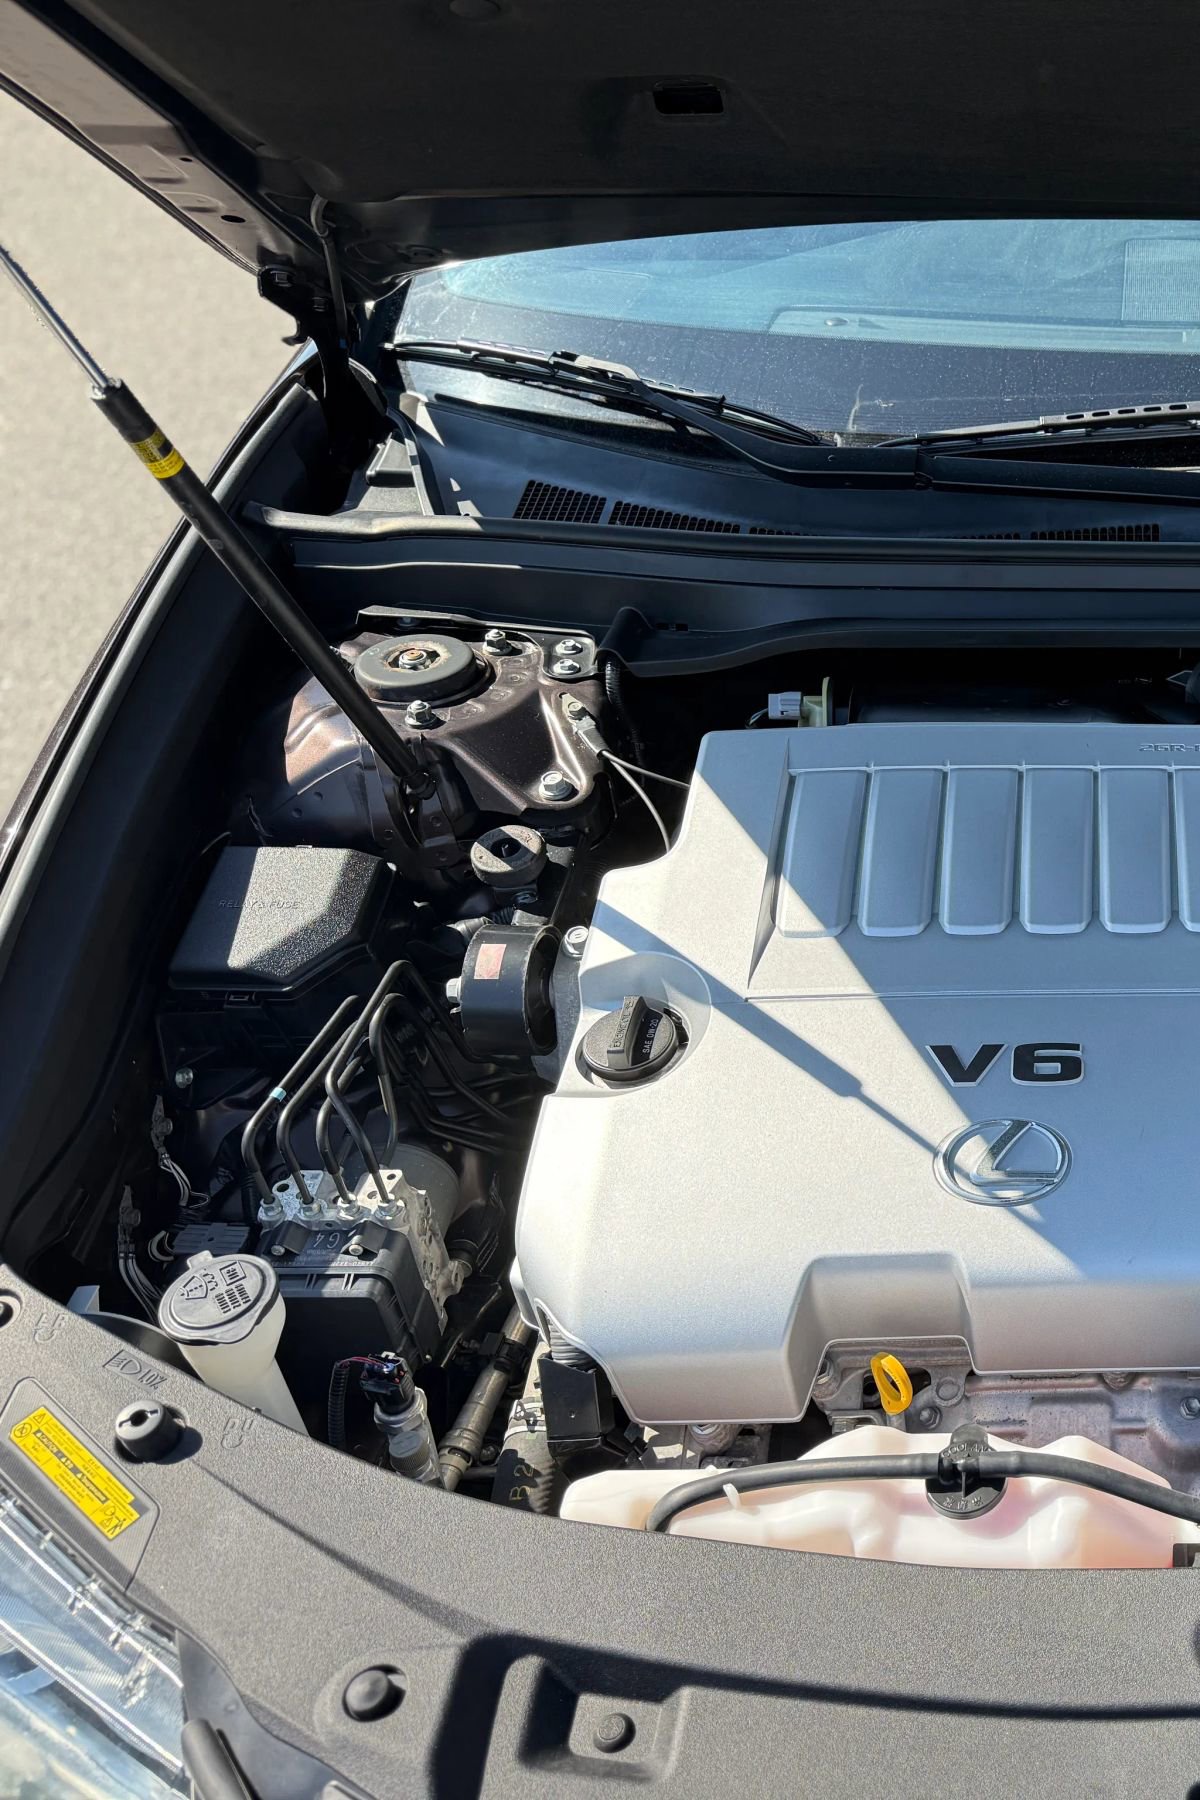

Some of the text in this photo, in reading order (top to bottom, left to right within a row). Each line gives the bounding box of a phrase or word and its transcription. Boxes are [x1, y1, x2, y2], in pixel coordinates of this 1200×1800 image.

[269, 901, 301, 910] FUSE
[642, 1018, 659, 1054] SAE 0W-20
[924, 1041, 1085, 1088] V6
[40, 1434, 58, 1454] CAUTION
